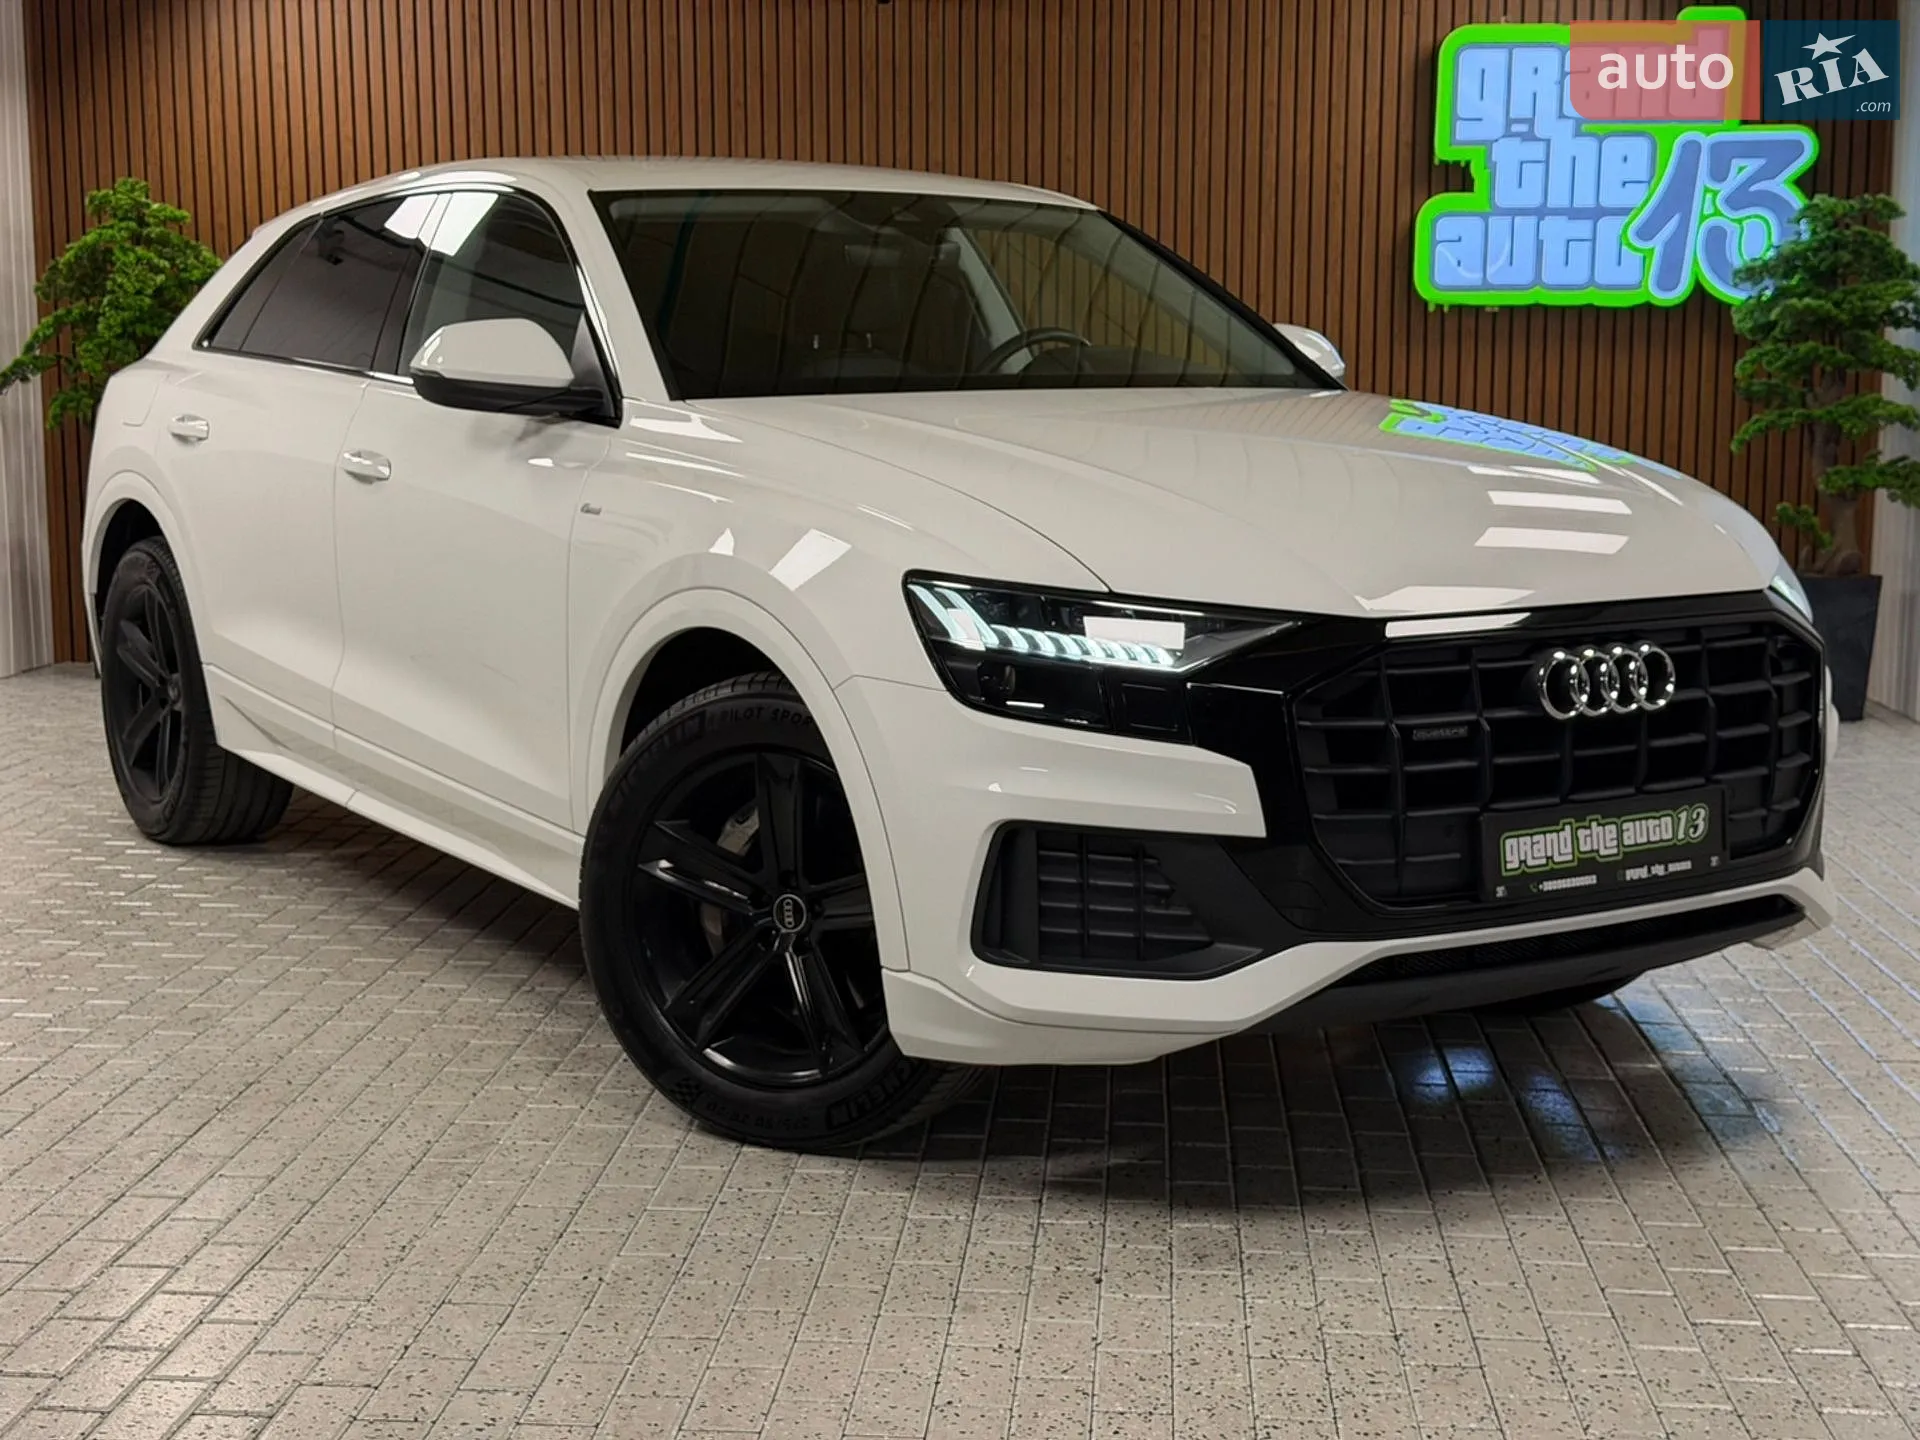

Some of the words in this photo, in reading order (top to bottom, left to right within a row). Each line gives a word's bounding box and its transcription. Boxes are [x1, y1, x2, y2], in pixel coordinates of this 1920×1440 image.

[1492, 118, 1652, 208] the
[1629, 132, 1815, 298] 13
[1505, 825, 1573, 869] grand
[1578, 822, 1619, 856] the
[1622, 815, 1672, 846] auto
[1676, 807, 1707, 841] 13
